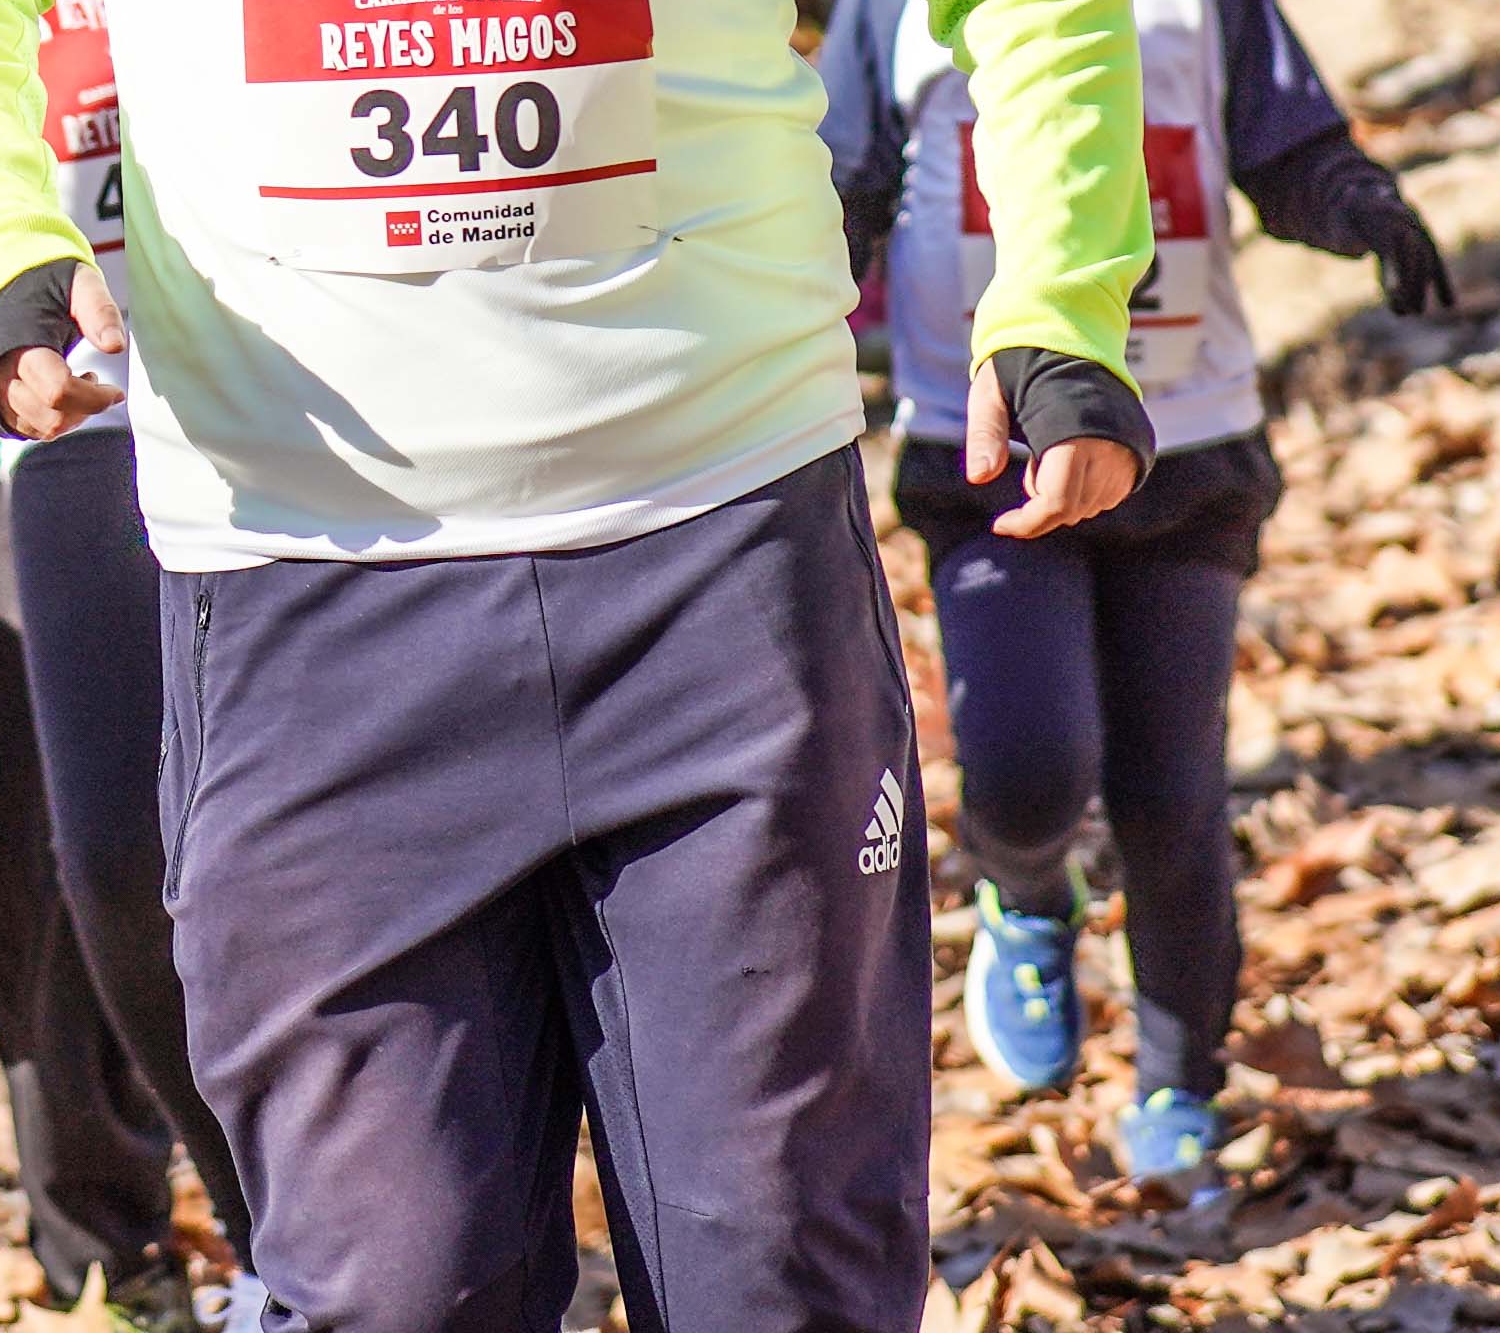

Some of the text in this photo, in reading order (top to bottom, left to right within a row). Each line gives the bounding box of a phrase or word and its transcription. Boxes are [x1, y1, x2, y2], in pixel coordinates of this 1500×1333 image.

[432, 4, 463, 15] de los
[320, 11, 577, 71] REYES MAGOS
[350, 81, 561, 178] 340
[427, 202, 535, 223] Comunidad
[428, 222, 535, 245] de Madrid
[858, 831, 900, 875] adid
